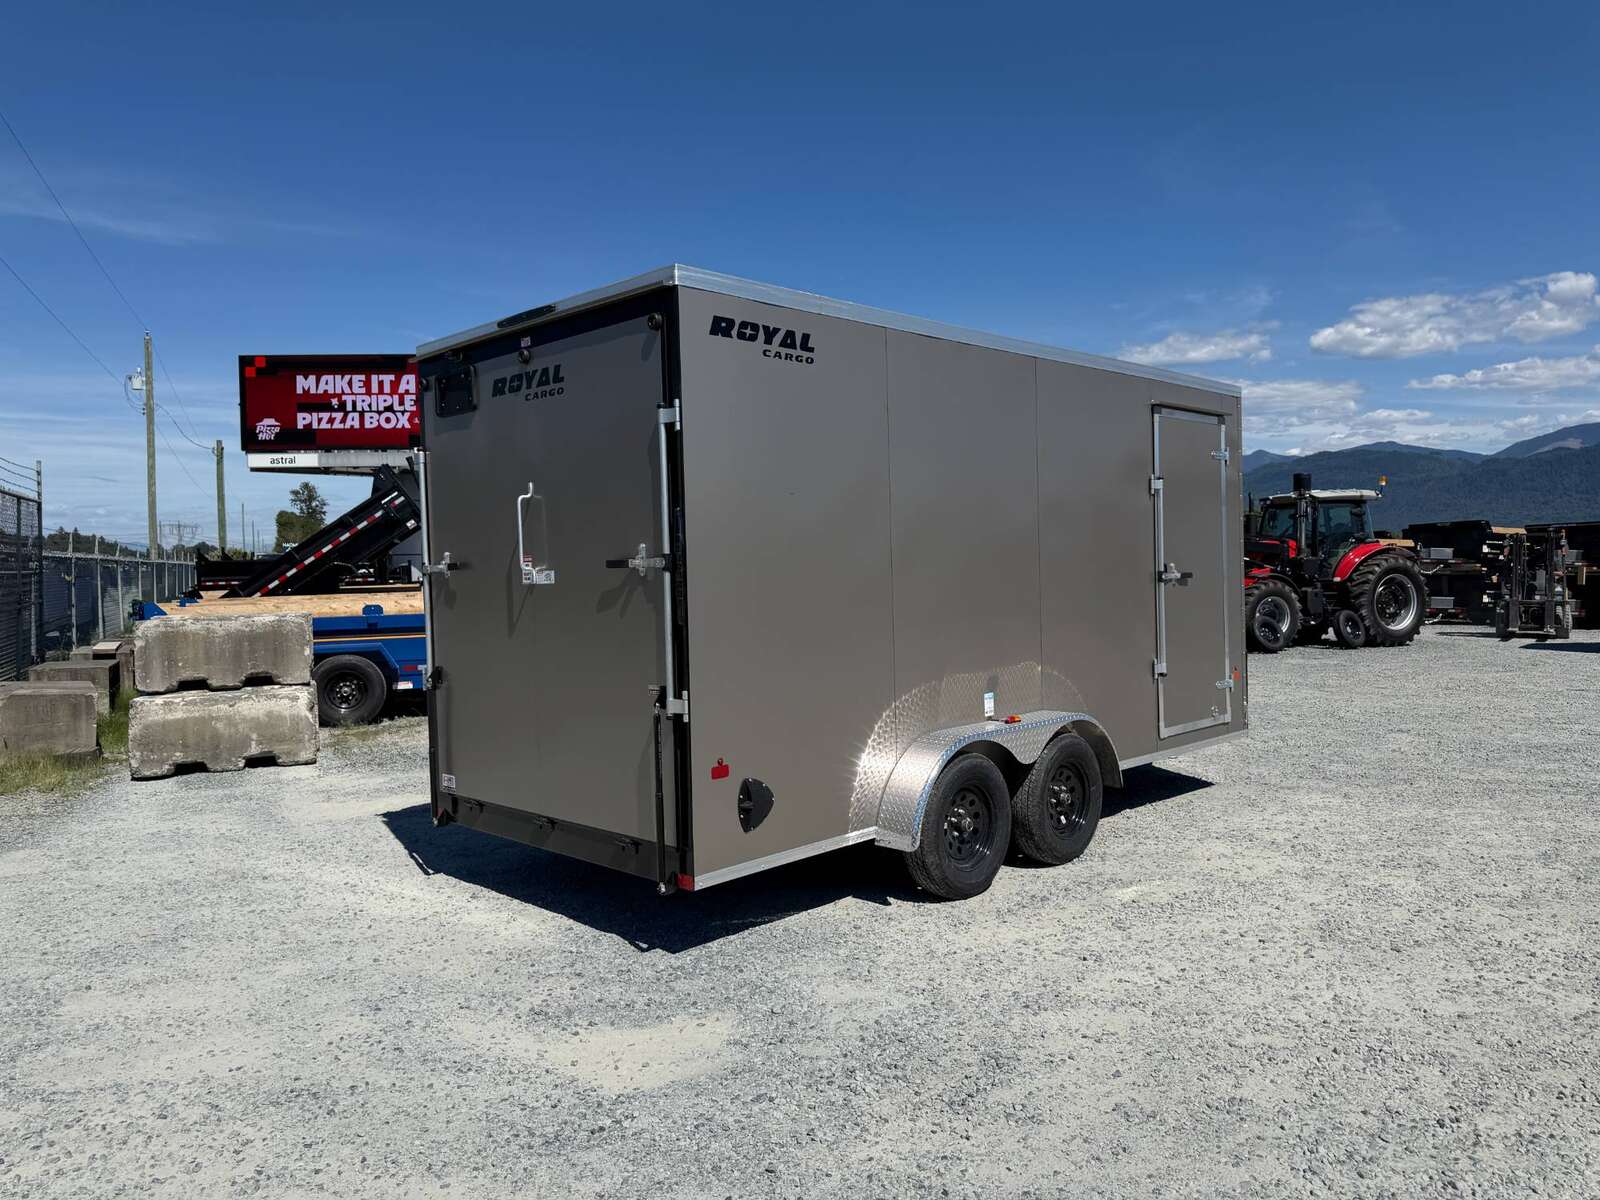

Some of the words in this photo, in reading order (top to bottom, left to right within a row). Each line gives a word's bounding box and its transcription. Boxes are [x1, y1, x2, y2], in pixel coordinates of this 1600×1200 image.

[709, 315, 815, 353] ROYAL
[762, 349, 815, 365] CARGO
[296, 374, 366, 394] MAKE
[371, 374, 396, 394] IT
[398, 374, 416, 394] A
[492, 364, 565, 398] ROYAL
[525, 387, 565, 401] CARGO
[341, 395, 417, 412] TRIPLE
[297, 412, 360, 429] PIZZA
[364, 412, 411, 429] BOX
[256, 424, 280, 434] Pizza
[257, 431, 276, 440] Hut
[270, 456, 296, 464] astral
